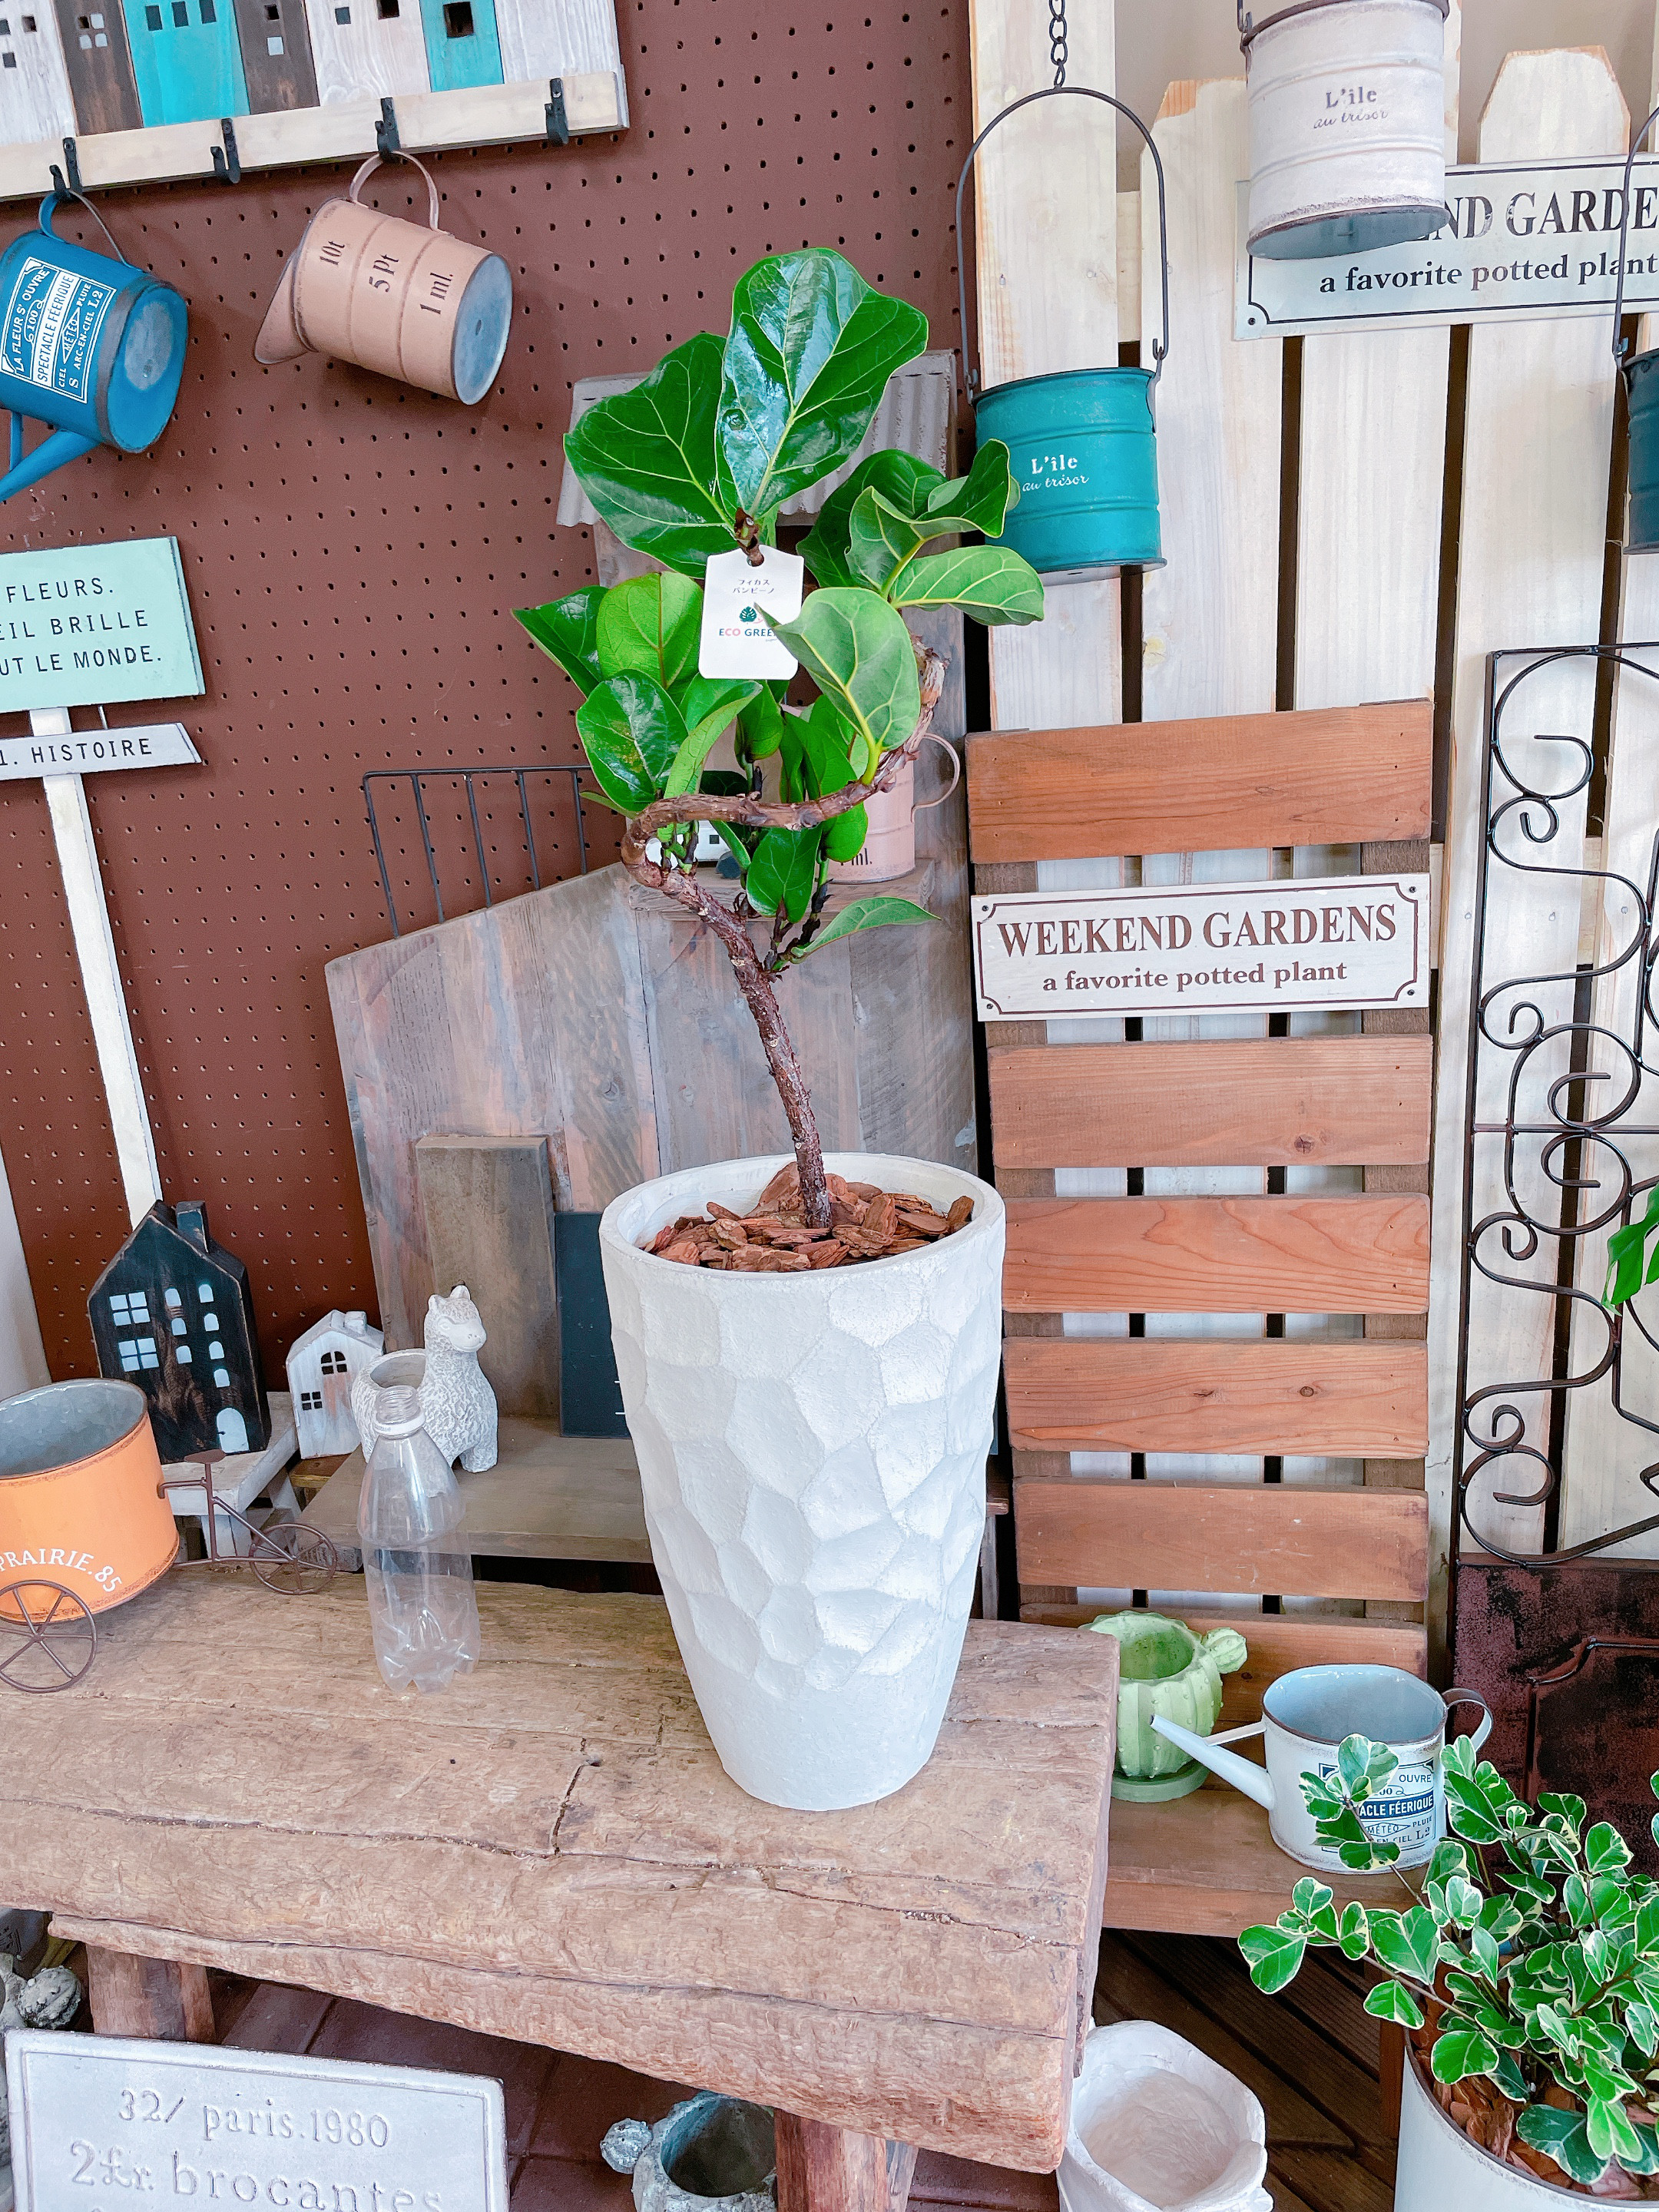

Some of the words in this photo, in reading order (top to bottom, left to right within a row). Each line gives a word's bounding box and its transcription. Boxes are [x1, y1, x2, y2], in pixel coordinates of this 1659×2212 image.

[22, 269, 51, 301] OUVRE
[1320, 277, 1336, 293] a
[1345, 261, 1462, 291] favorite
[1471, 253, 1569, 291] potted
[1578, 252, 1658, 286] plant
[88, 290, 104, 309] L2
[12, 316, 24, 354] FLEUR
[26, 311, 39, 333] 100
[38, 320, 55, 382] SPECTACLE
[48, 275, 75, 323] FÉERIQUE
[58, 368, 67, 387] CIEL
[76, 283, 91, 307] PLUIE
[73, 312, 95, 370] ARC-EN-CIEL
[14, 358, 25, 373] LA
[69, 377, 79, 389] S
[1022, 482, 1041, 492] au
[6, 578, 114, 604] FLEURS.
[51, 610, 148, 636] BRILLE
[719, 628, 741, 637] ECO
[744, 628, 776, 637] GREE
[35, 654, 63, 673] LE
[74, 645, 162, 668] MONDE.
[31, 738, 152, 763] HISTOIRE
[997, 915, 1192, 958] WEEKEND
[1203, 903, 1396, 949] GARDENS
[1042, 977, 1058, 991] a
[1065, 967, 1168, 991] favorite
[1176, 962, 1265, 993] potted
[1273, 961, 1347, 989] plant
[1399, 1774, 1432, 1783] OUVRE
[1389, 1794, 1433, 1816] FÉERIQUE
